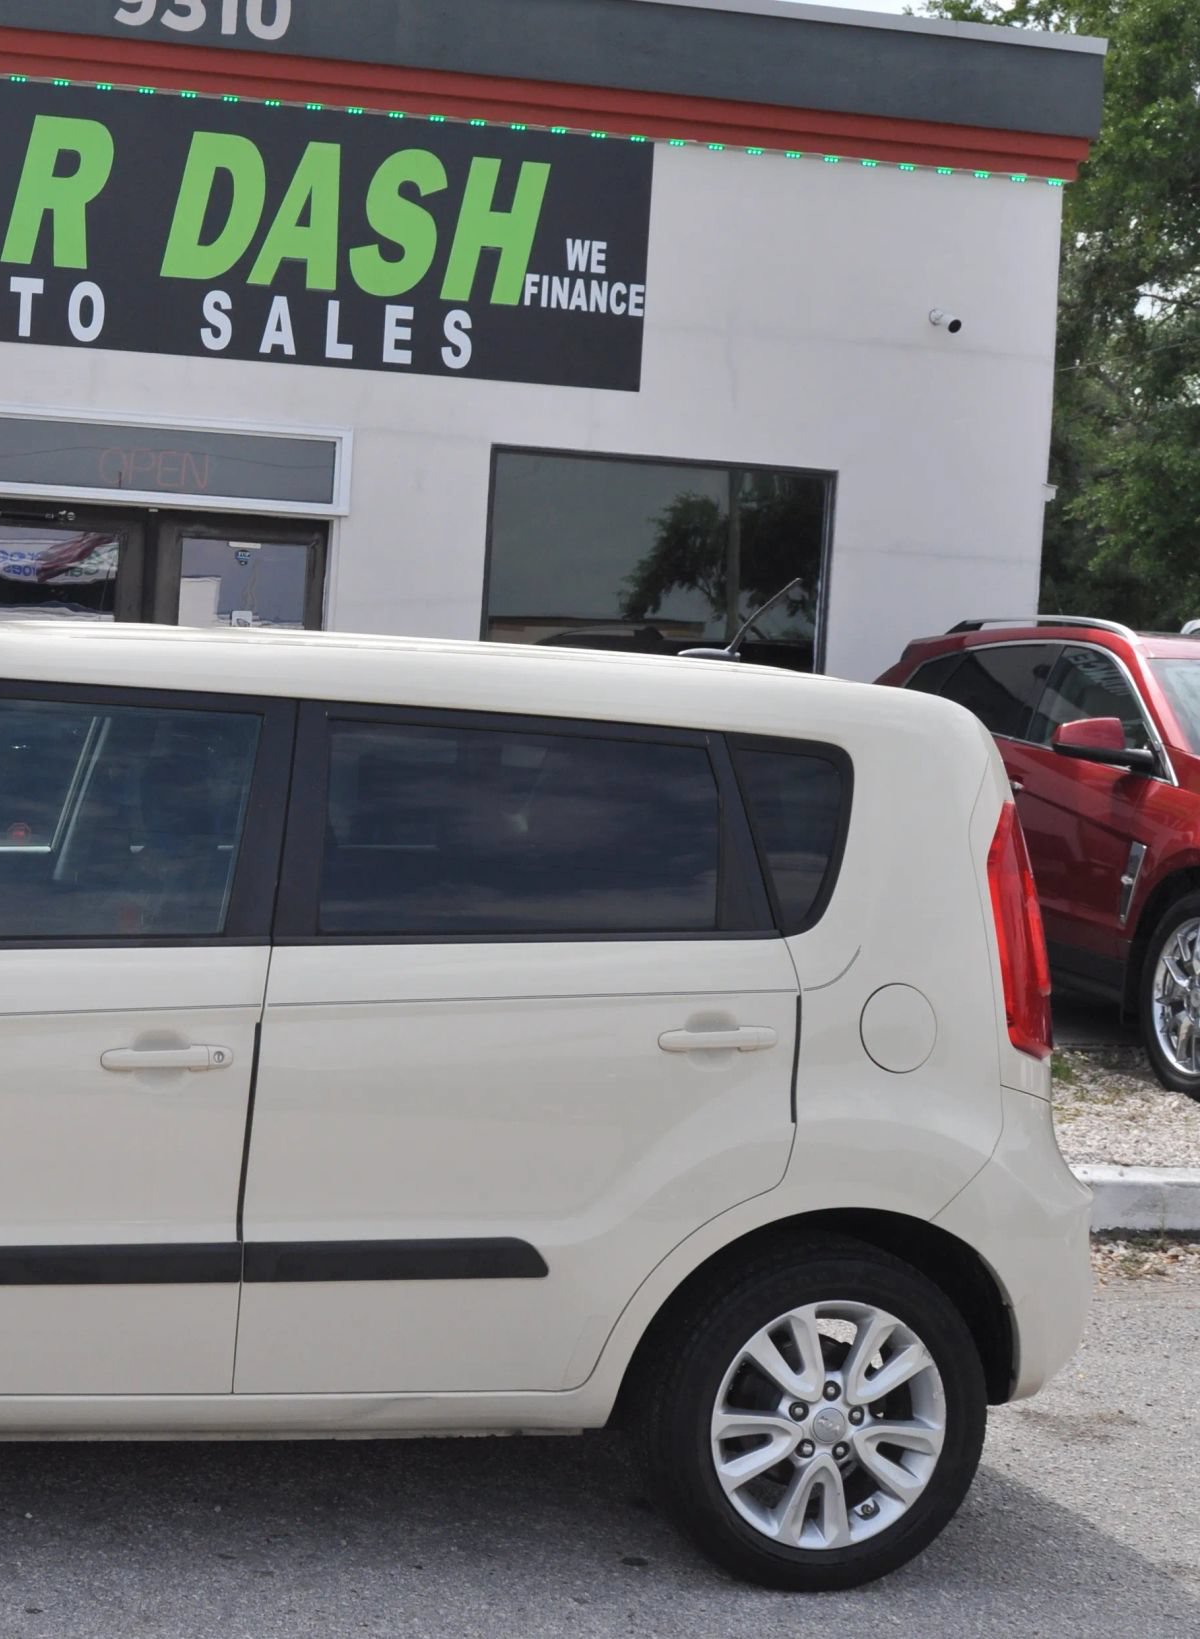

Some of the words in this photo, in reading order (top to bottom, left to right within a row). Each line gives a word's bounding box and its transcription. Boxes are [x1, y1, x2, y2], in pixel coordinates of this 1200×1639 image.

[160, 131, 550, 305] DASH
[566, 237, 608, 274] WE
[523, 273, 646, 317] FINANCE
[200, 289, 473, 370] SALES
[98, 447, 209, 490] OPEN
